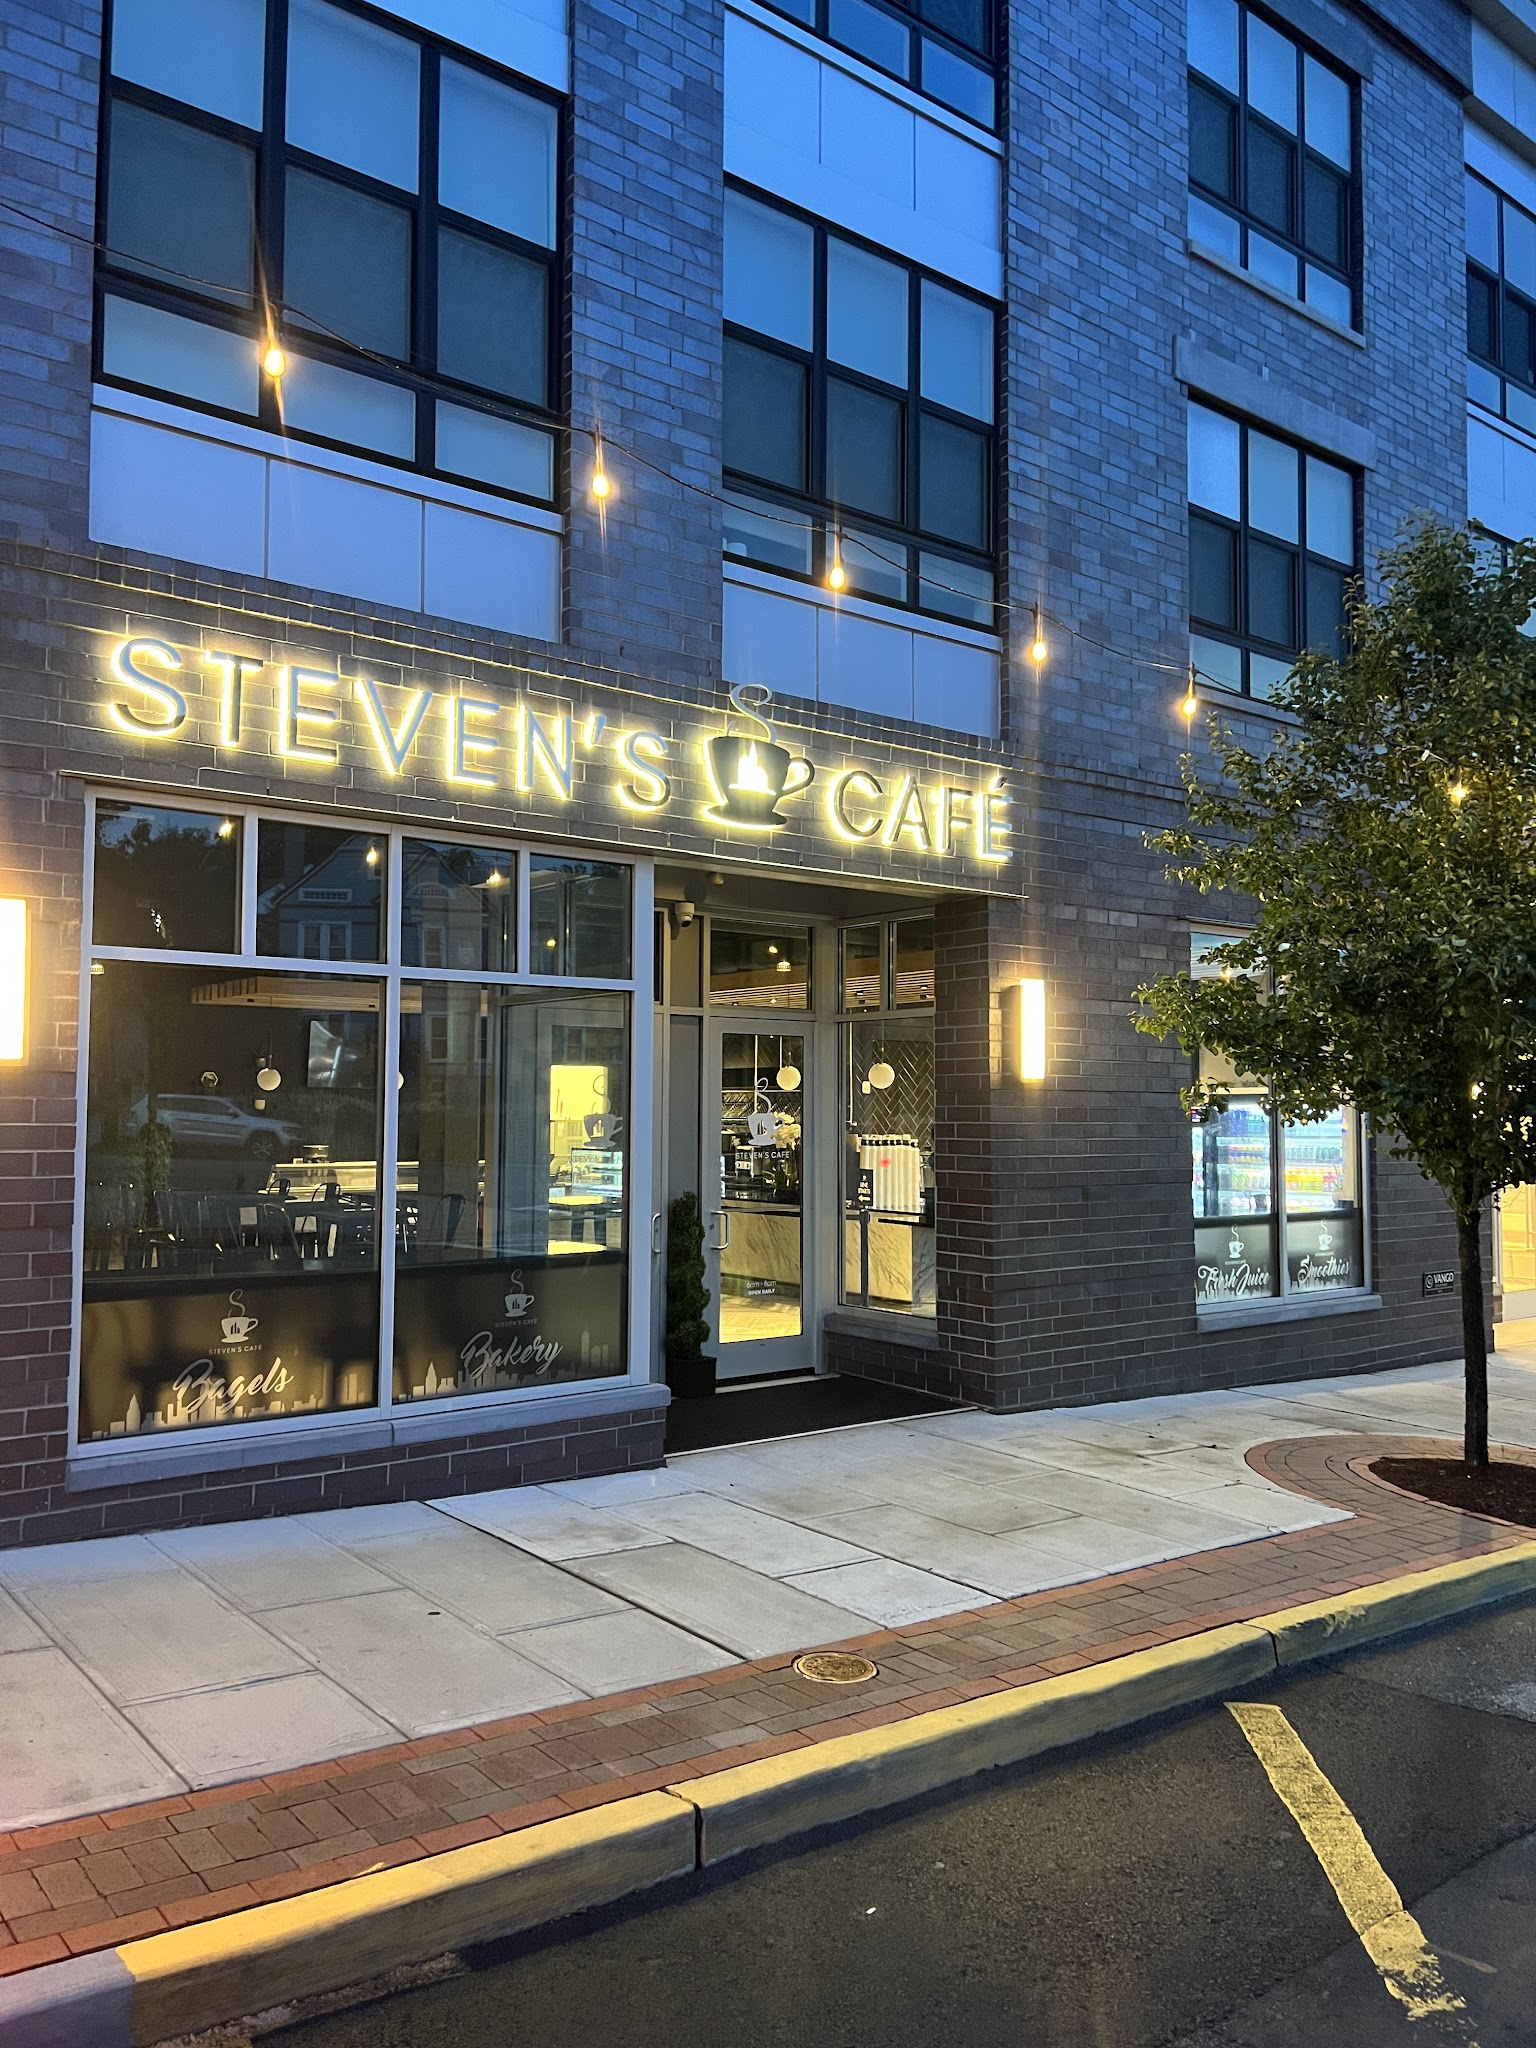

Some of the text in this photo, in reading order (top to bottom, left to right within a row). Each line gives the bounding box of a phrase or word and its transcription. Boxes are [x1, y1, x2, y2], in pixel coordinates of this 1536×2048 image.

[109, 636, 1014, 860] STEVEN'S CAFÉ
[734, 1151, 770, 1160] STEVEN'S
[1197, 1263, 1270, 1295] Fresh Juice
[1297, 1254, 1350, 1284] Smoothies
[208, 1346, 243, 1356] STEVEN'S
[460, 1331, 564, 1380] Bakery
[172, 1356, 294, 1414] Bagels
